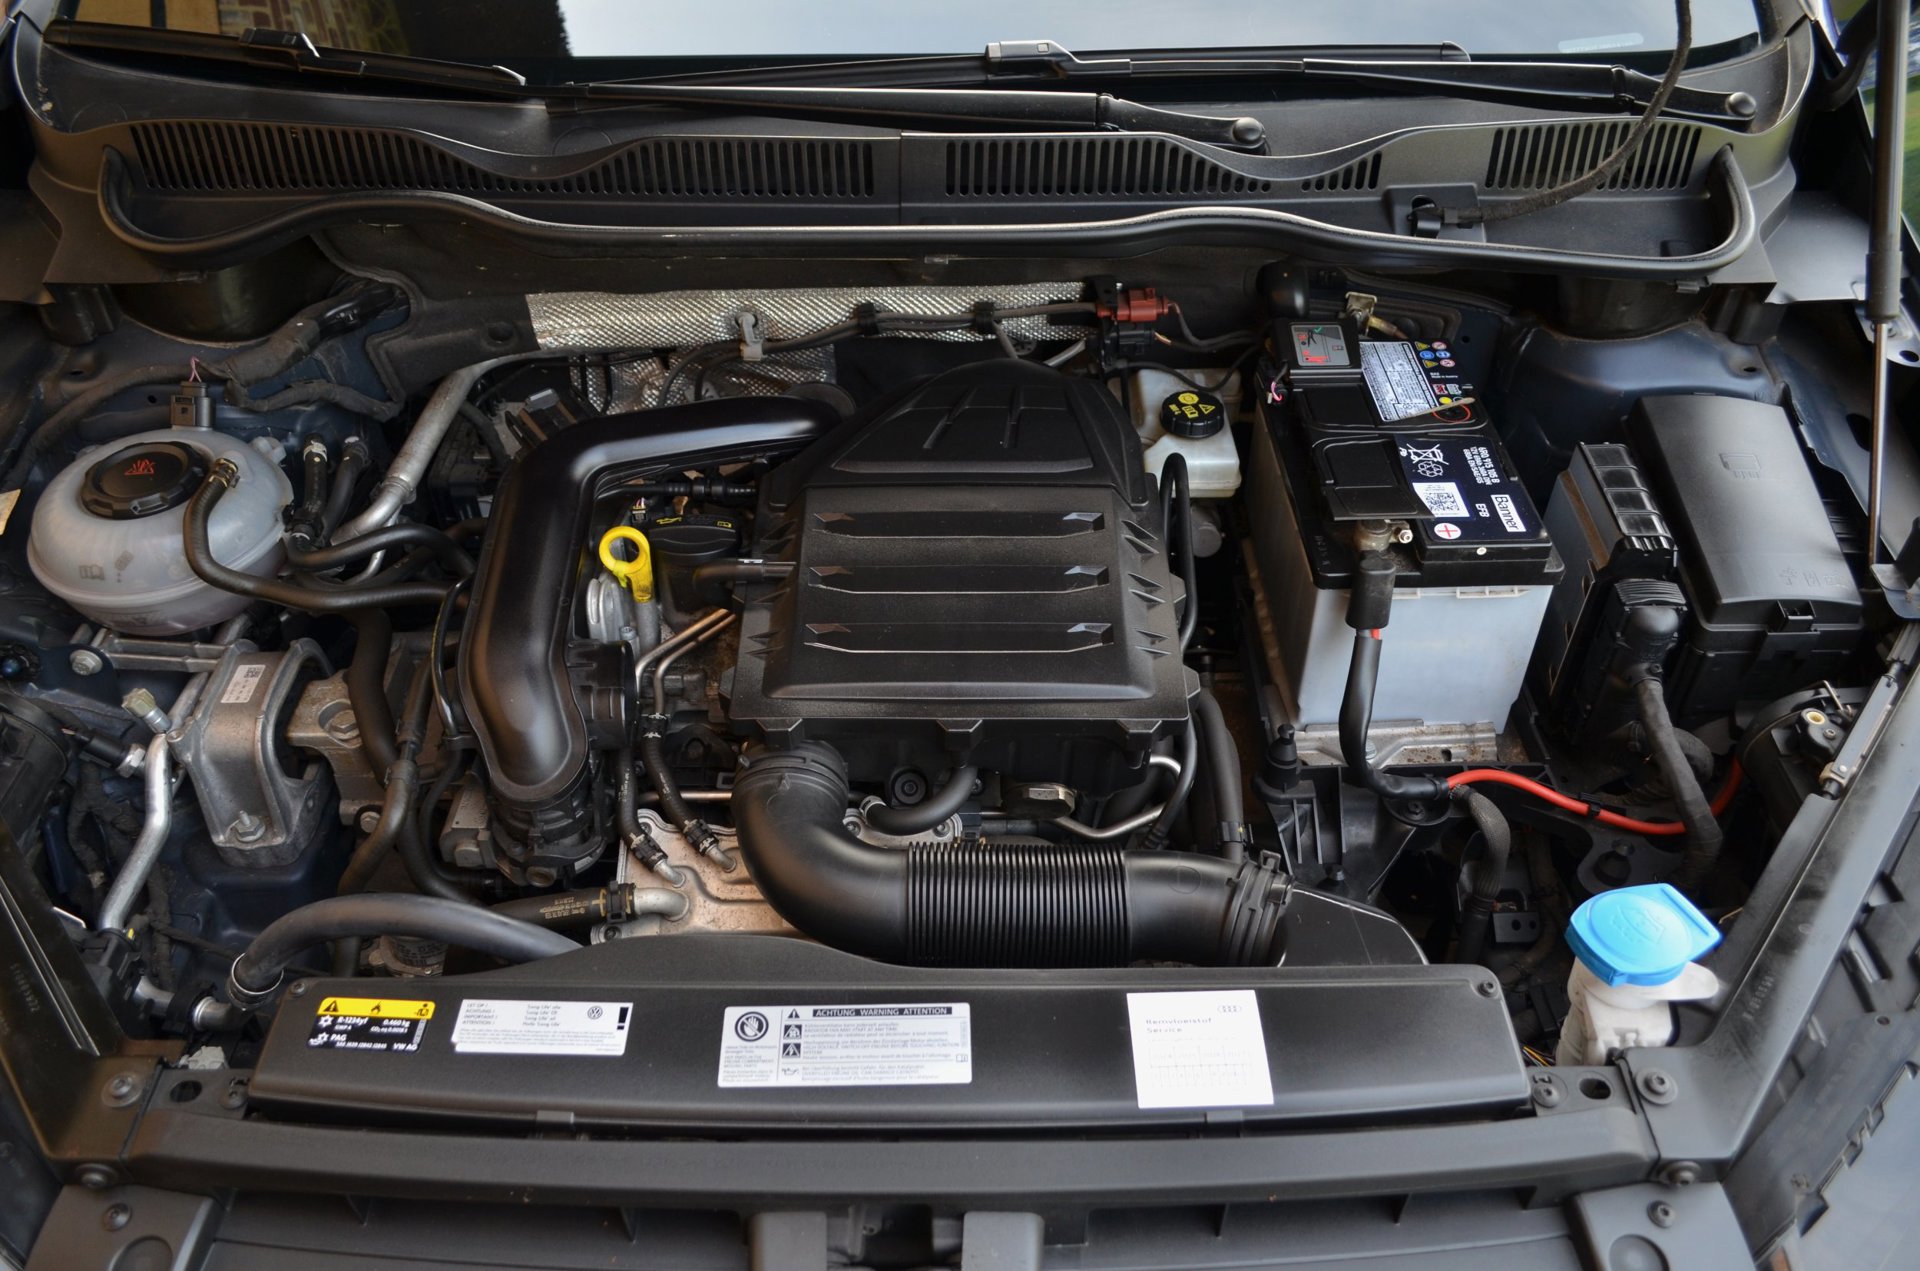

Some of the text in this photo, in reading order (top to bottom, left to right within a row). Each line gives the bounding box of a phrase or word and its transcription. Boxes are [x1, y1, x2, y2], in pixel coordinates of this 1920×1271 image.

[1483, 458, 1494, 468] 915
[1475, 503, 1490, 518] EFB
[1495, 496, 1518, 530] Banner
[337, 1016, 369, 1024] R-1234yf
